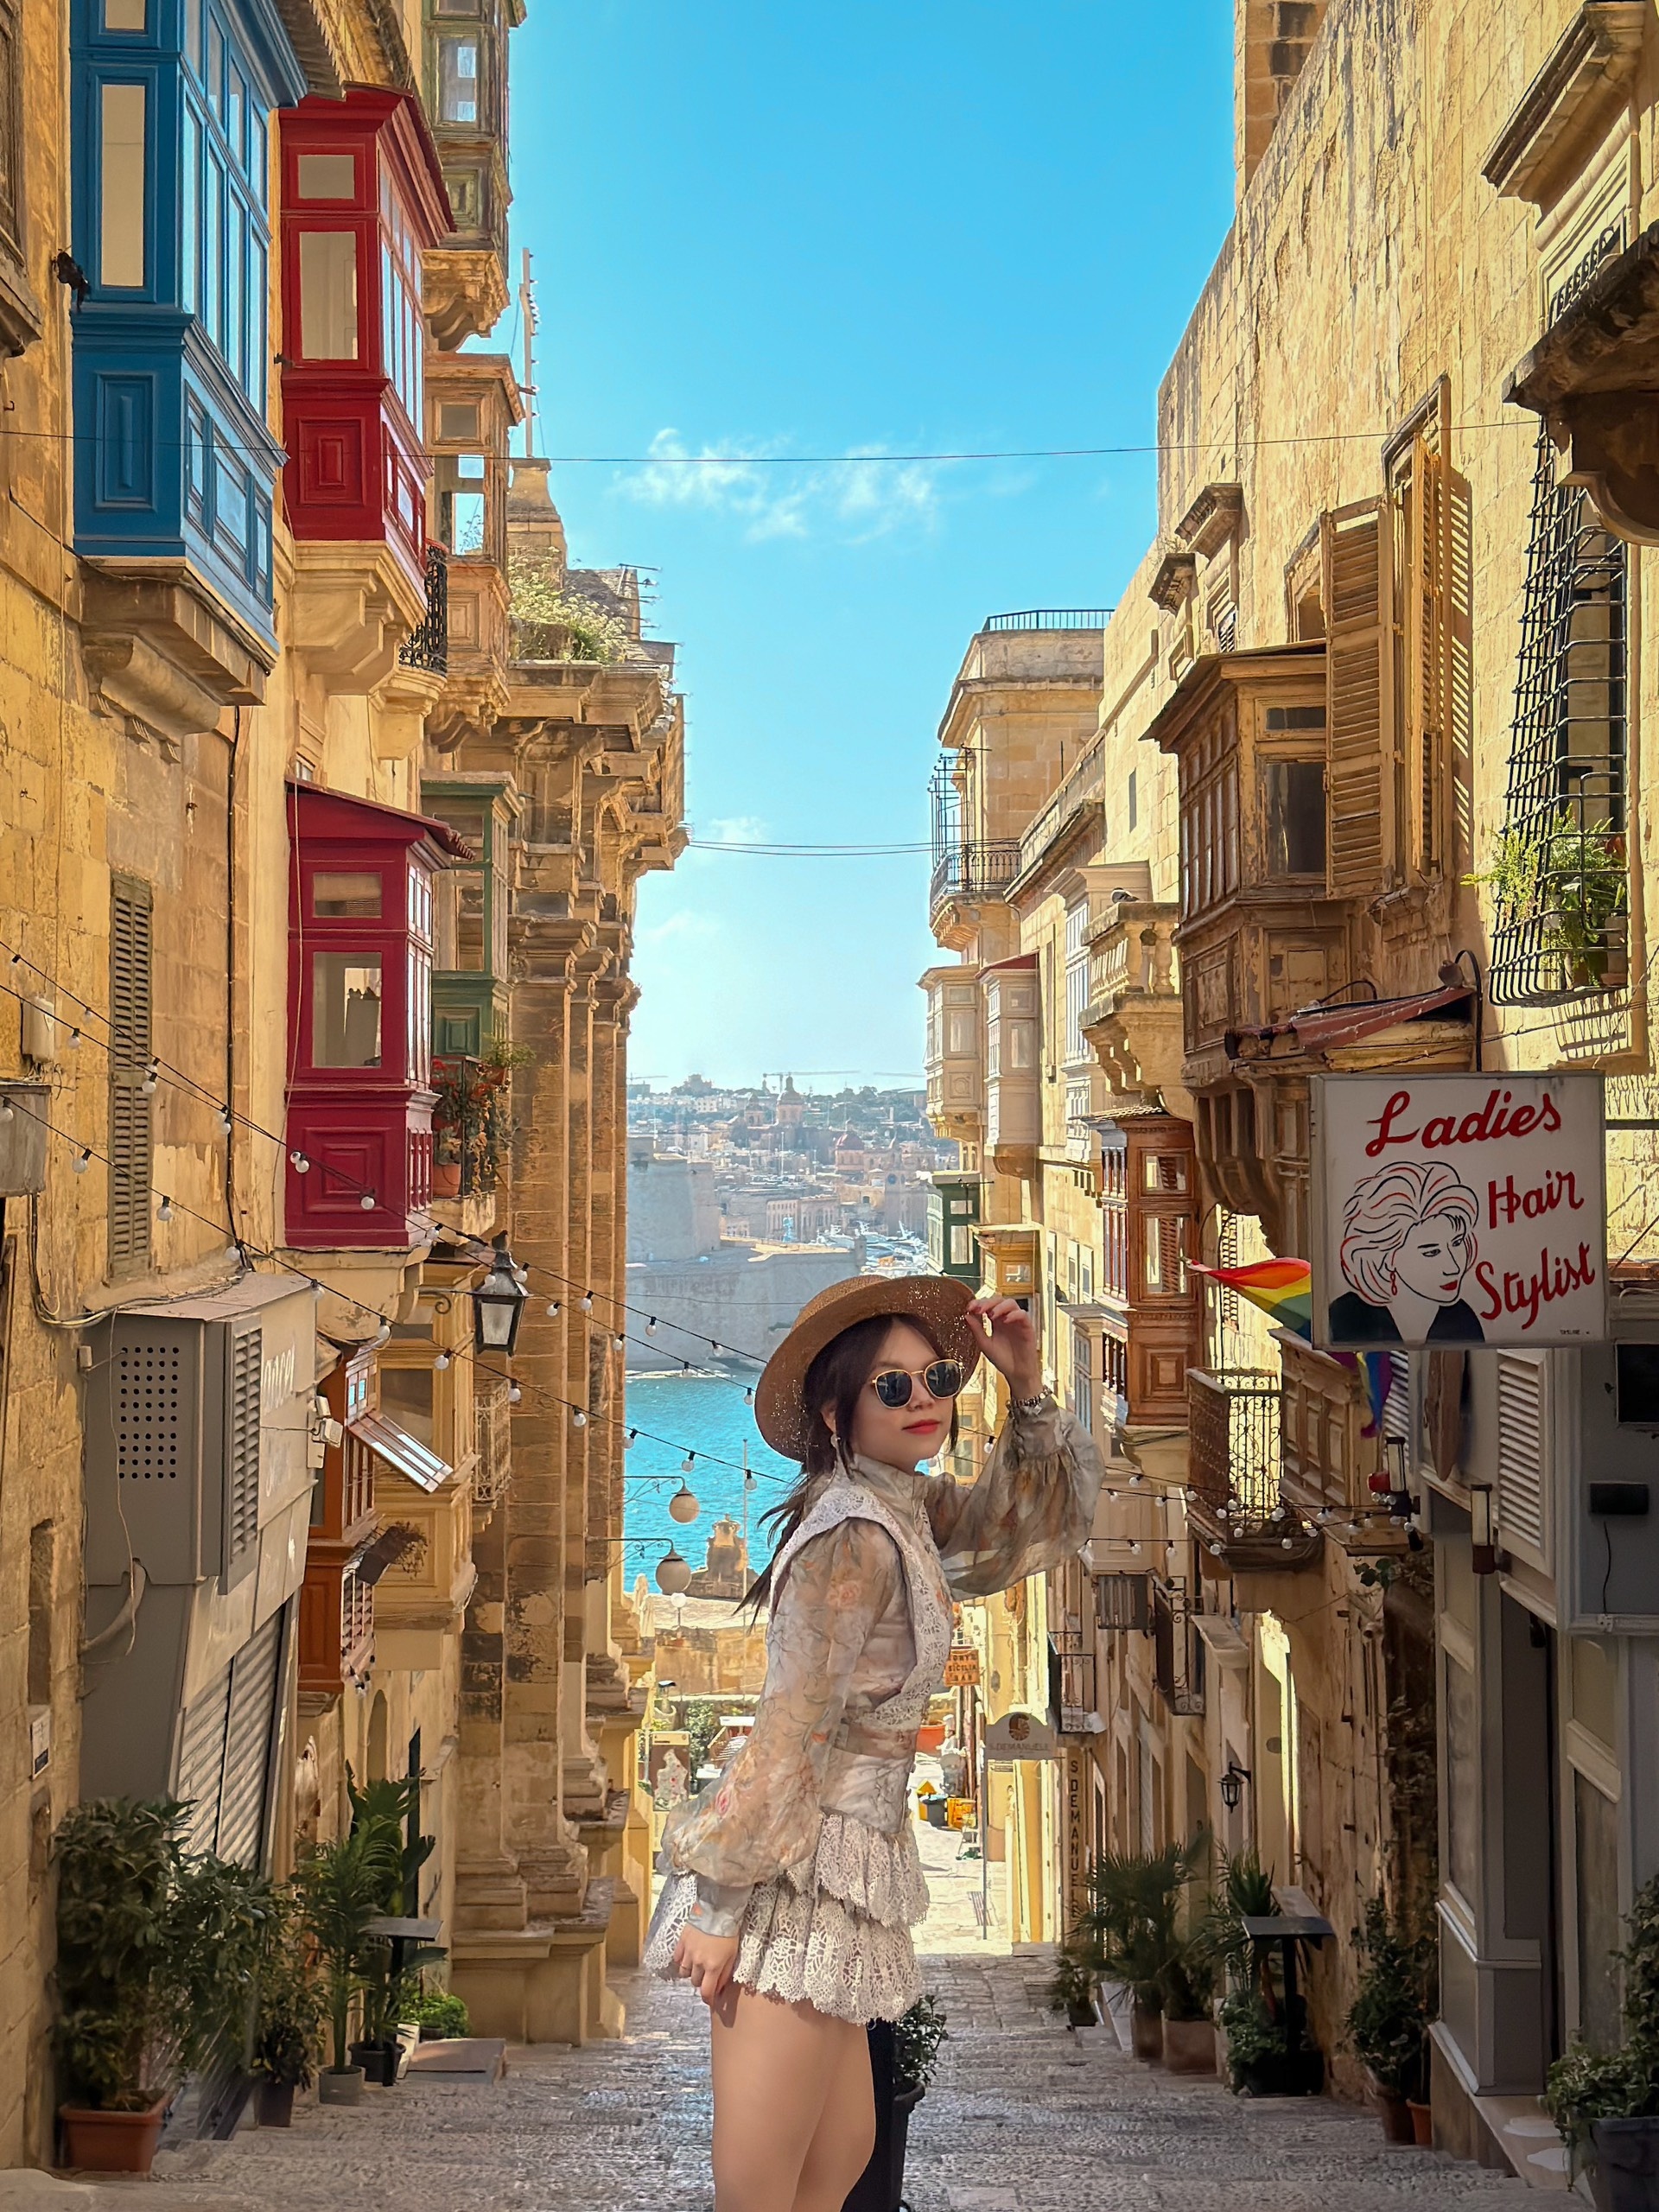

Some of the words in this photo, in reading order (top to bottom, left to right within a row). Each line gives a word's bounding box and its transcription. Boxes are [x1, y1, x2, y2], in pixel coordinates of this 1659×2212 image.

[1365, 1089, 1561, 1157] Ladies
[1487, 1169, 1585, 1229] Hair
[1474, 1241, 1596, 1330] Stylist
